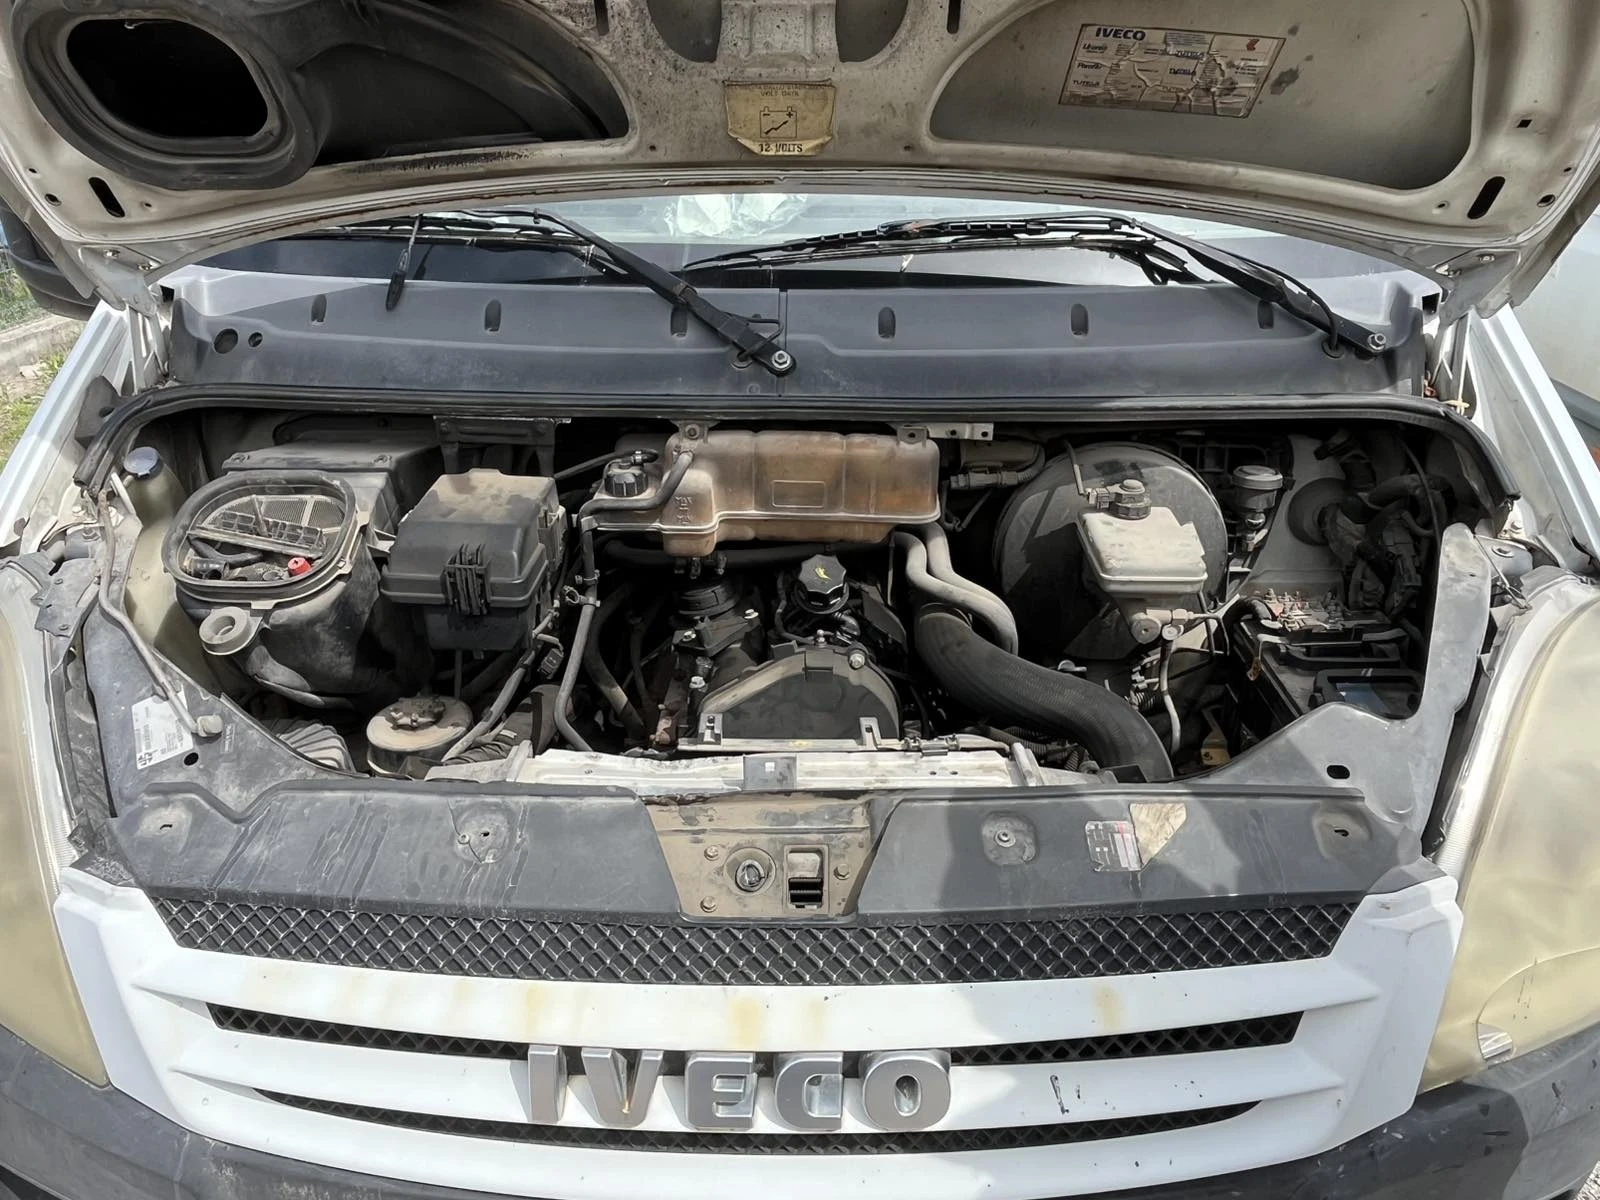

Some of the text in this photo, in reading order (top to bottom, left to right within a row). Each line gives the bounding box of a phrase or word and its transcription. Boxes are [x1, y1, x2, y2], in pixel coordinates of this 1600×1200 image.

[1096, 27, 1146, 41] IVECO
[758, 143, 803, 153] 12 VOLTS
[528, 1045, 952, 1132] IVECO
